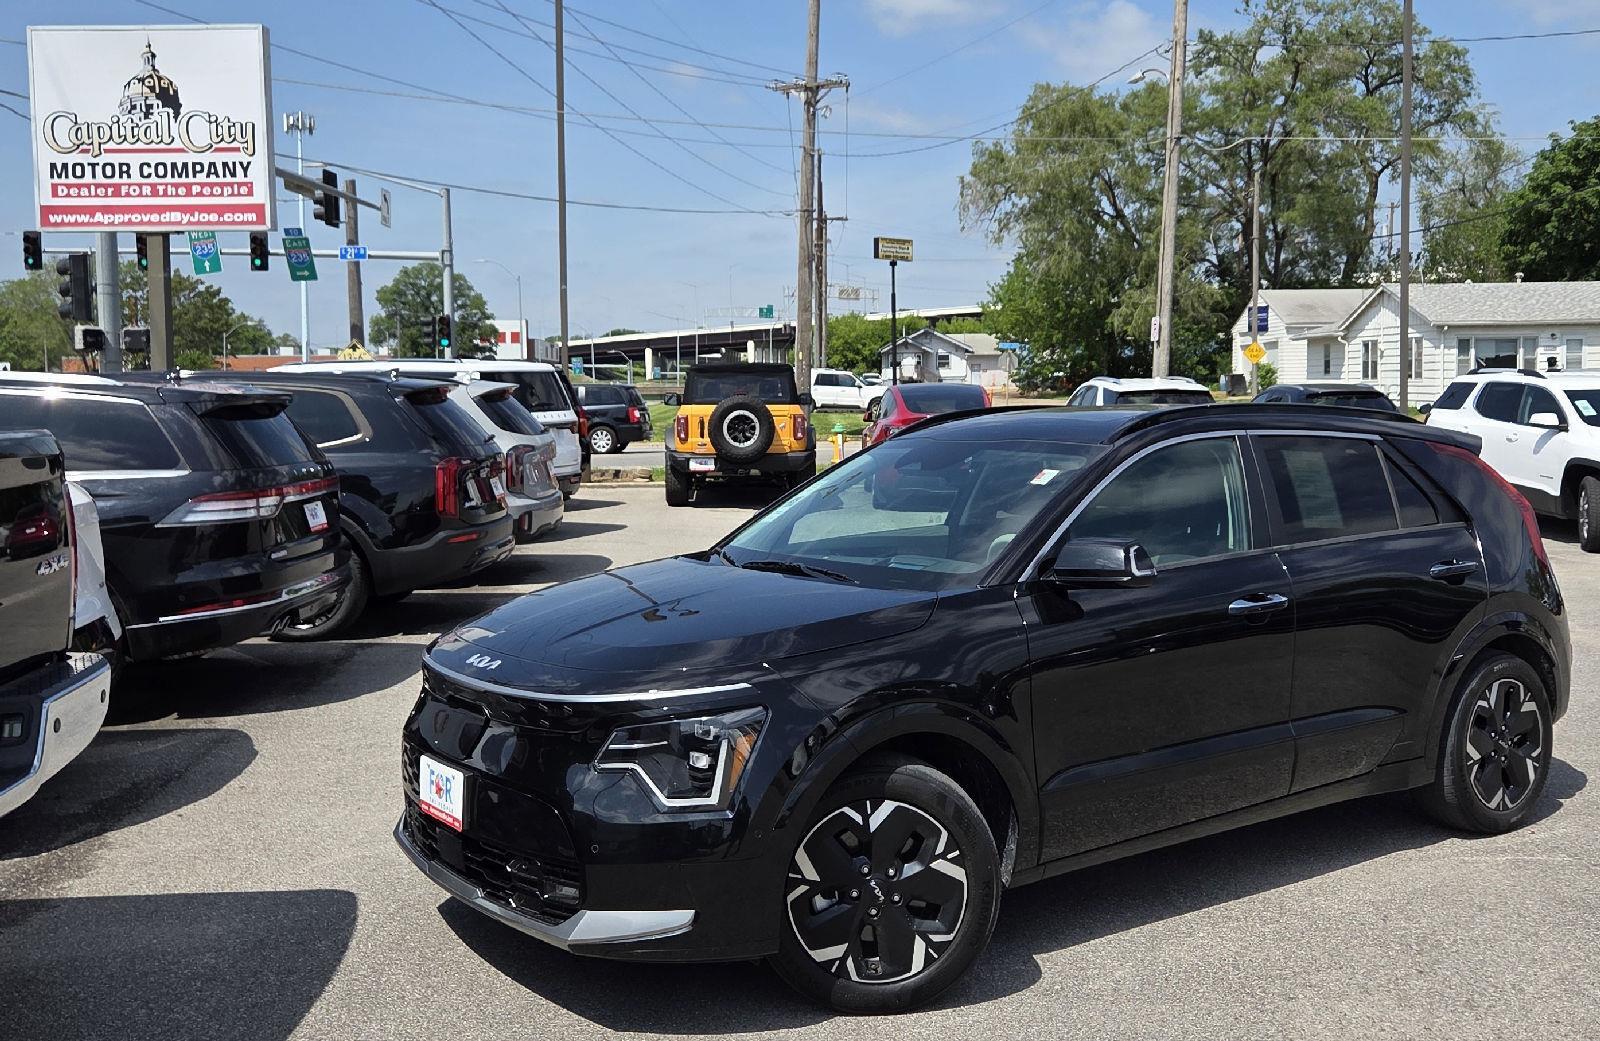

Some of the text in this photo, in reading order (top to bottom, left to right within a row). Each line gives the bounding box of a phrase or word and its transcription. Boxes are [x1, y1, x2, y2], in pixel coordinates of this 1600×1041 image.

[43, 111, 256, 158] Capital City
[50, 161, 251, 179] MOTOR COMPANY
[57, 186, 114, 197] Dealer
[121, 185, 152, 196] FOR
[157, 185, 187, 196] The
[49, 211, 257, 224] www.ApprovedByJoe.com
[195, 243, 214, 255] 235
[291, 252, 309, 262] 235
